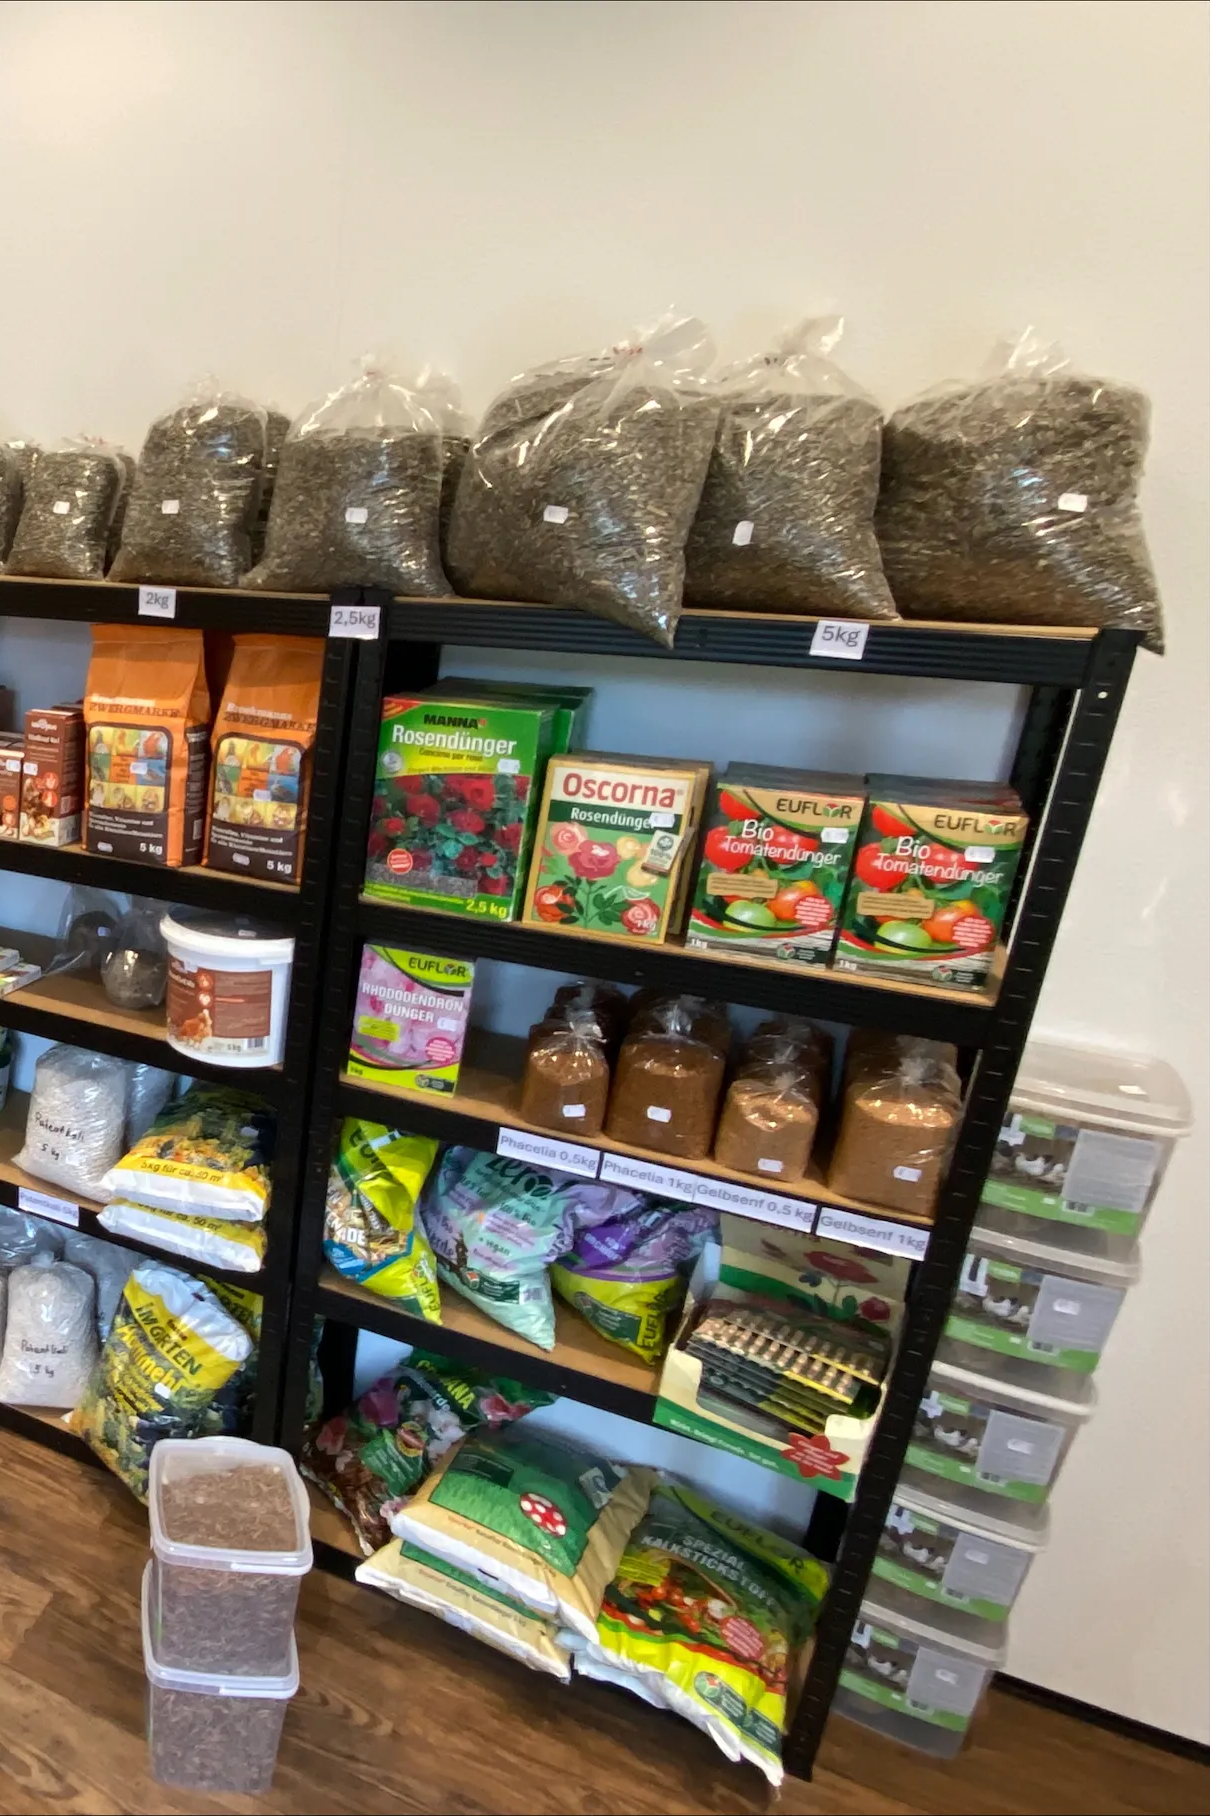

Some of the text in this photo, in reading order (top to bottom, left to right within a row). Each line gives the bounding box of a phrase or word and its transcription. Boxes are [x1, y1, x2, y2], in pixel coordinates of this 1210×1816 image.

[145, 592, 170, 610] 2kg
[334, 611, 377, 629] 2,5kg
[821, 625, 861, 647] 5kg
[423, 713, 480, 730] MANNA
[391, 724, 518, 758] Rosendünger
[562, 772, 677, 809] Oscorna
[741, 817, 775, 841] Bio
[139, 842, 164, 856] 5 kg
[720, 835, 842, 869] Tomatendünger
[895, 835, 931, 860] Bio
[265, 859, 293, 875] 5 kg
[871, 851, 1005, 888] Tomatendünger
[465, 898, 508, 919] 2,5 kg
[362, 981, 464, 1013] RHODODENDRON
[500, 1135, 597, 1172] Phacelia 0,5kg
[140, 1160, 161, 1173] 5kg
[161, 1164, 178, 1174] für
[604, 1161, 693, 1195] Phacelia 1kg
[696, 1183, 814, 1225] Gelbsenf 0,5 kg
[193, 1216, 208, 1227] 50
[820, 1214, 927, 1252] Gelbsenf 1kg
